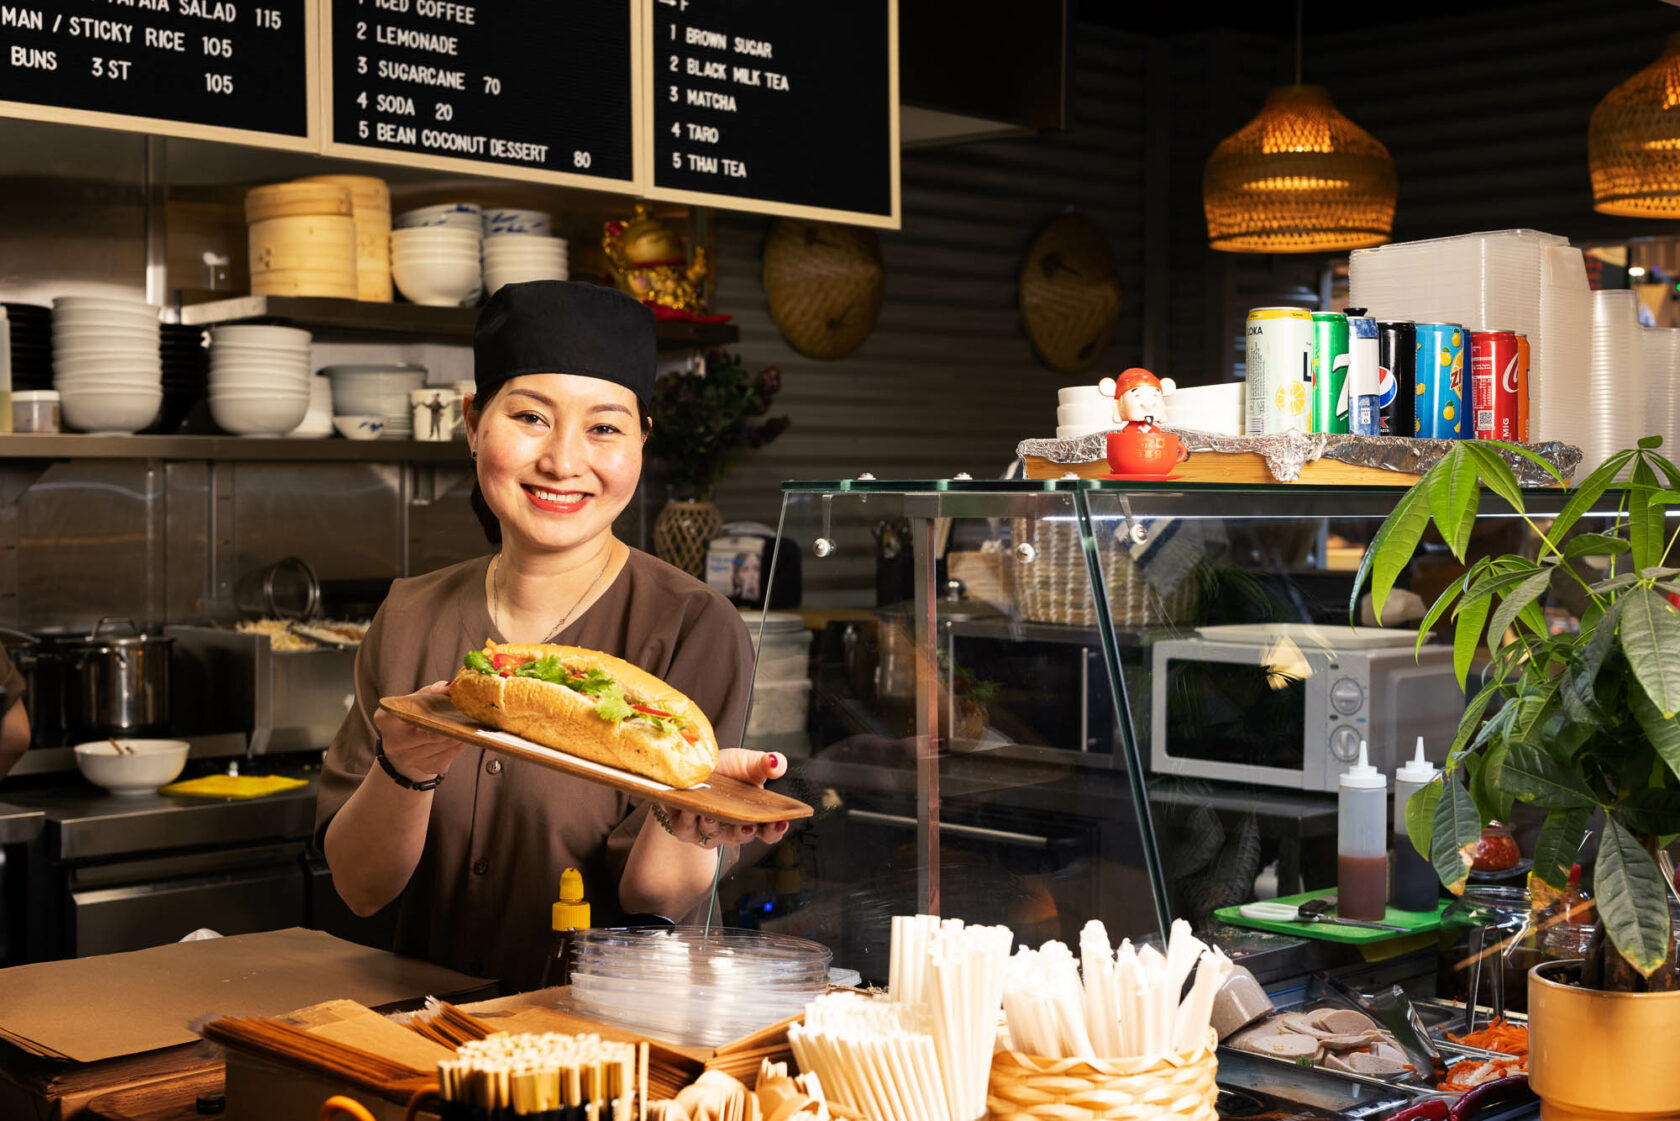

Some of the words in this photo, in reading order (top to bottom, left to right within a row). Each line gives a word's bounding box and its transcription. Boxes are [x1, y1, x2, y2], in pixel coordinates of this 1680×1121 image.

[178, 0, 237, 22] SALAD
[255, 8, 282, 29] 115
[416, 0, 475, 24] COFFEE
[1, 5, 43, 31] MAN
[52, 14, 63, 33] /
[68, 16, 133, 43] STICKY
[145, 27, 186, 51] RICE
[202, 36, 233, 58] 105
[356, 21, 367, 40] 2
[376, 24, 458, 55] LEMONADE
[670, 24, 676, 40] 1
[685, 26, 727, 50] BROWN
[733, 36, 773, 59] SUGAR
[10, 45, 58, 70] BUNS
[91, 57, 104, 77] 3
[107, 60, 132, 80] ST
[204, 72, 234, 94] 105
[357, 56, 368, 74] 3
[378, 59, 466, 90] SUGARCANE
[483, 76, 501, 95] 70
[669, 55, 679, 72] 2
[686, 57, 727, 80] BLACK
[732, 66, 761, 86] MILK
[764, 71, 790, 91] TEA
[356, 91, 368, 109] 4
[376, 94, 416, 116] SODA
[435, 102, 453, 121] 20
[669, 85, 679, 102] 3
[686, 88, 737, 112] MATCHA
[358, 120, 369, 139] 5
[376, 122, 417, 145] BEAN
[421, 128, 487, 154] COCONUT
[489, 138, 549, 163] DESSERT
[573, 150, 592, 168] 80
[670, 121, 681, 138] 4
[686, 123, 720, 144] TARO
[672, 152, 682, 169] 5
[687, 153, 718, 174] THAI
[721, 158, 747, 178] TEA
[1502, 417, 1510, 438] MIG
